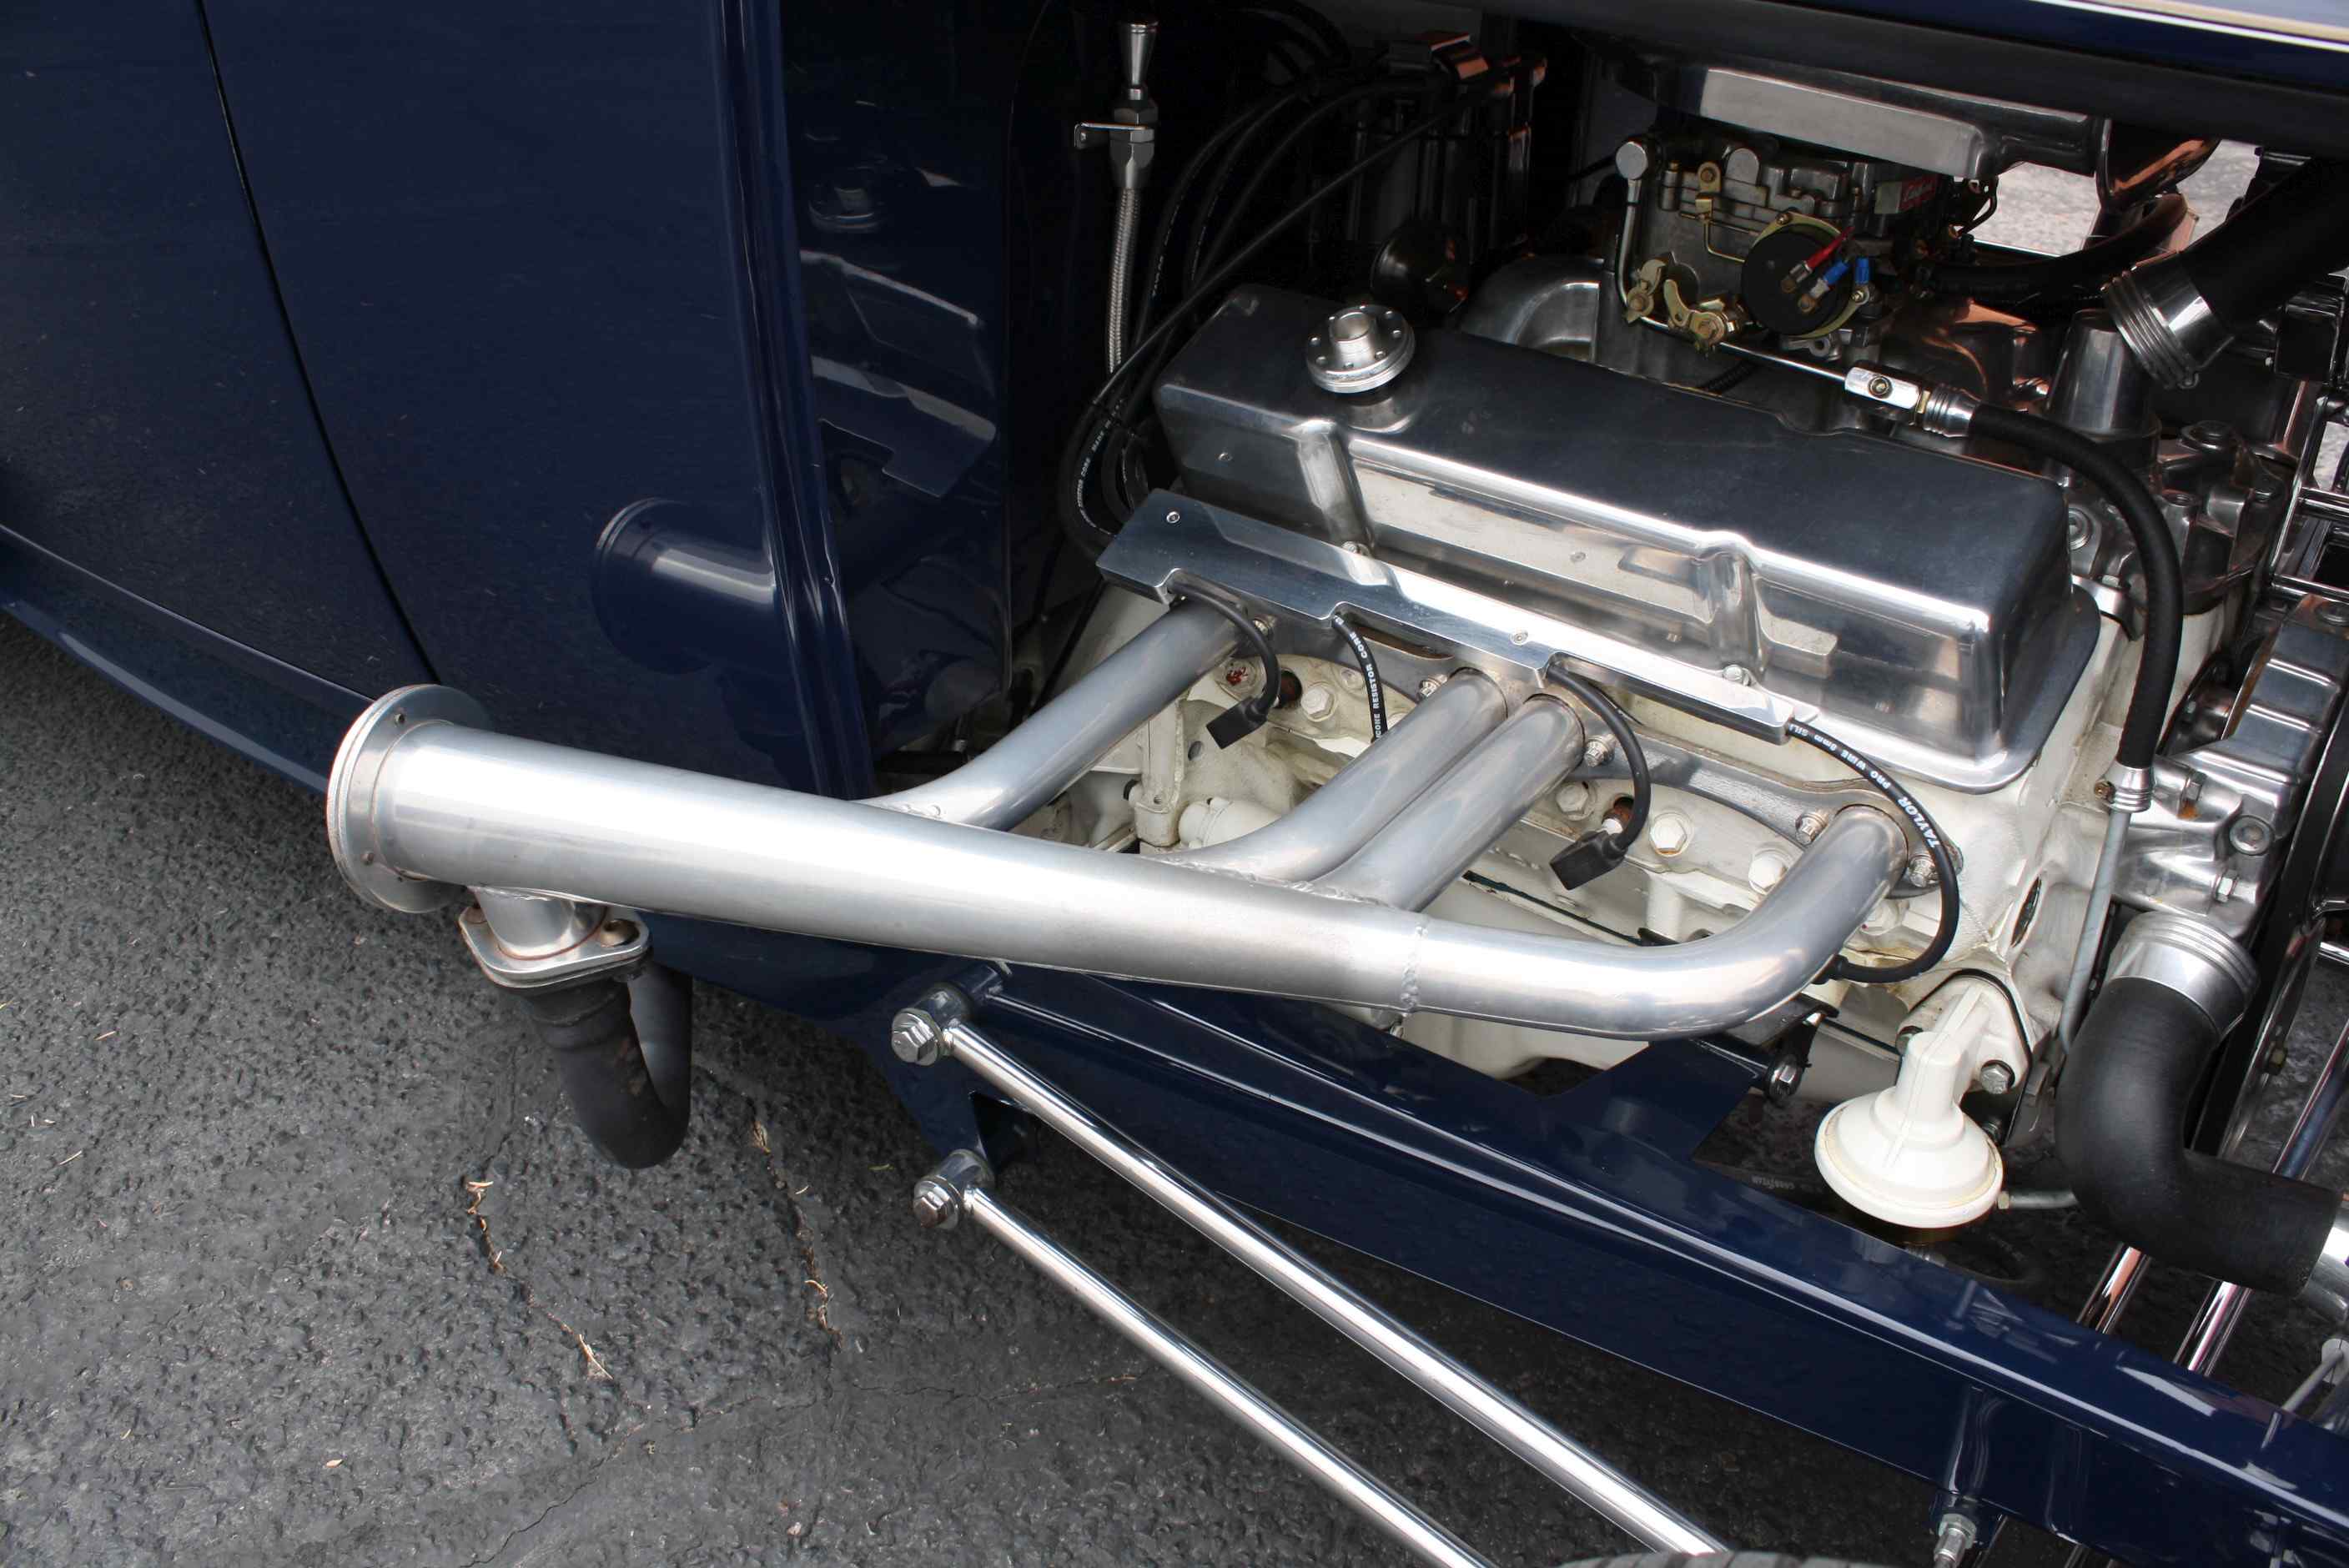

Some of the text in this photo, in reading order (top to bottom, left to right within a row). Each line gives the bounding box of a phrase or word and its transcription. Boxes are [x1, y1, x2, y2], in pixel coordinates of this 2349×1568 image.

[1350, 631, 1368, 659] CORE
[1366, 664, 1380, 709] RESISTOR
[1841, 750, 1867, 771] WIRE
[1869, 771, 1891, 790] PRO
[1898, 797, 1941, 848] TAYLOR
